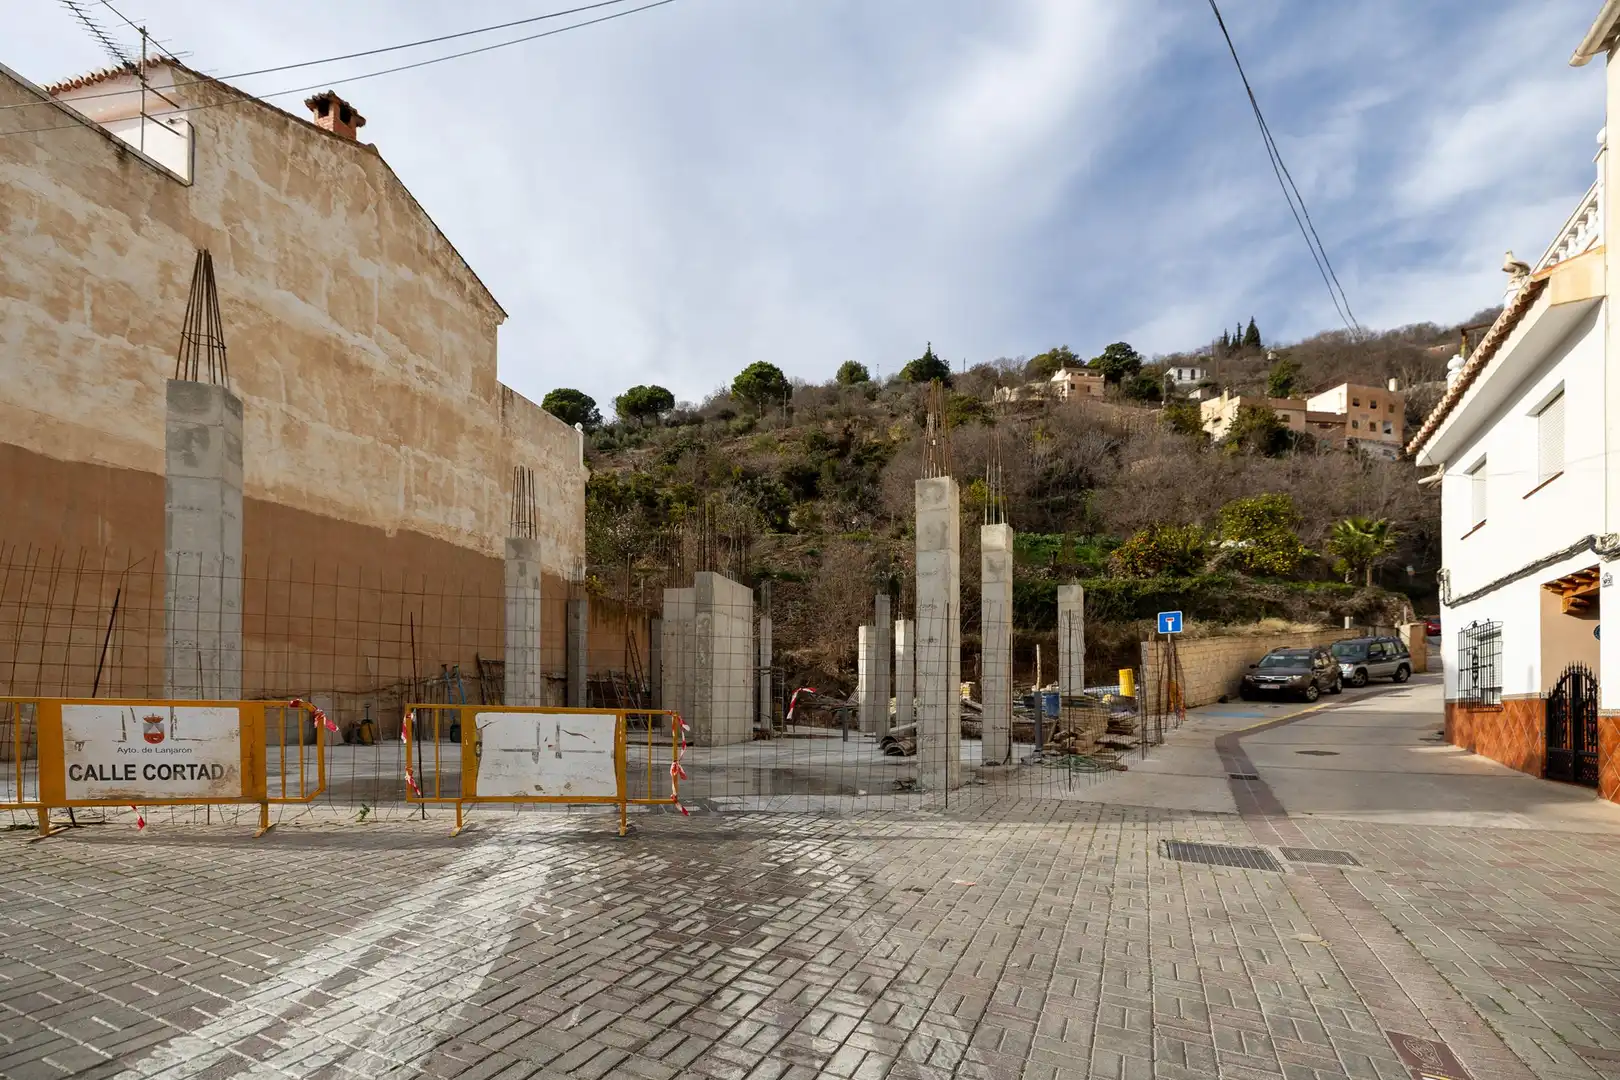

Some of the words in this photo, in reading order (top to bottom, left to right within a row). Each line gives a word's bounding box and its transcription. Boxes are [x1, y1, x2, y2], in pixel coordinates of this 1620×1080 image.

[117, 746, 140, 755] Ayto.
[141, 746, 153, 754] de
[68, 764, 137, 782] CALLE
